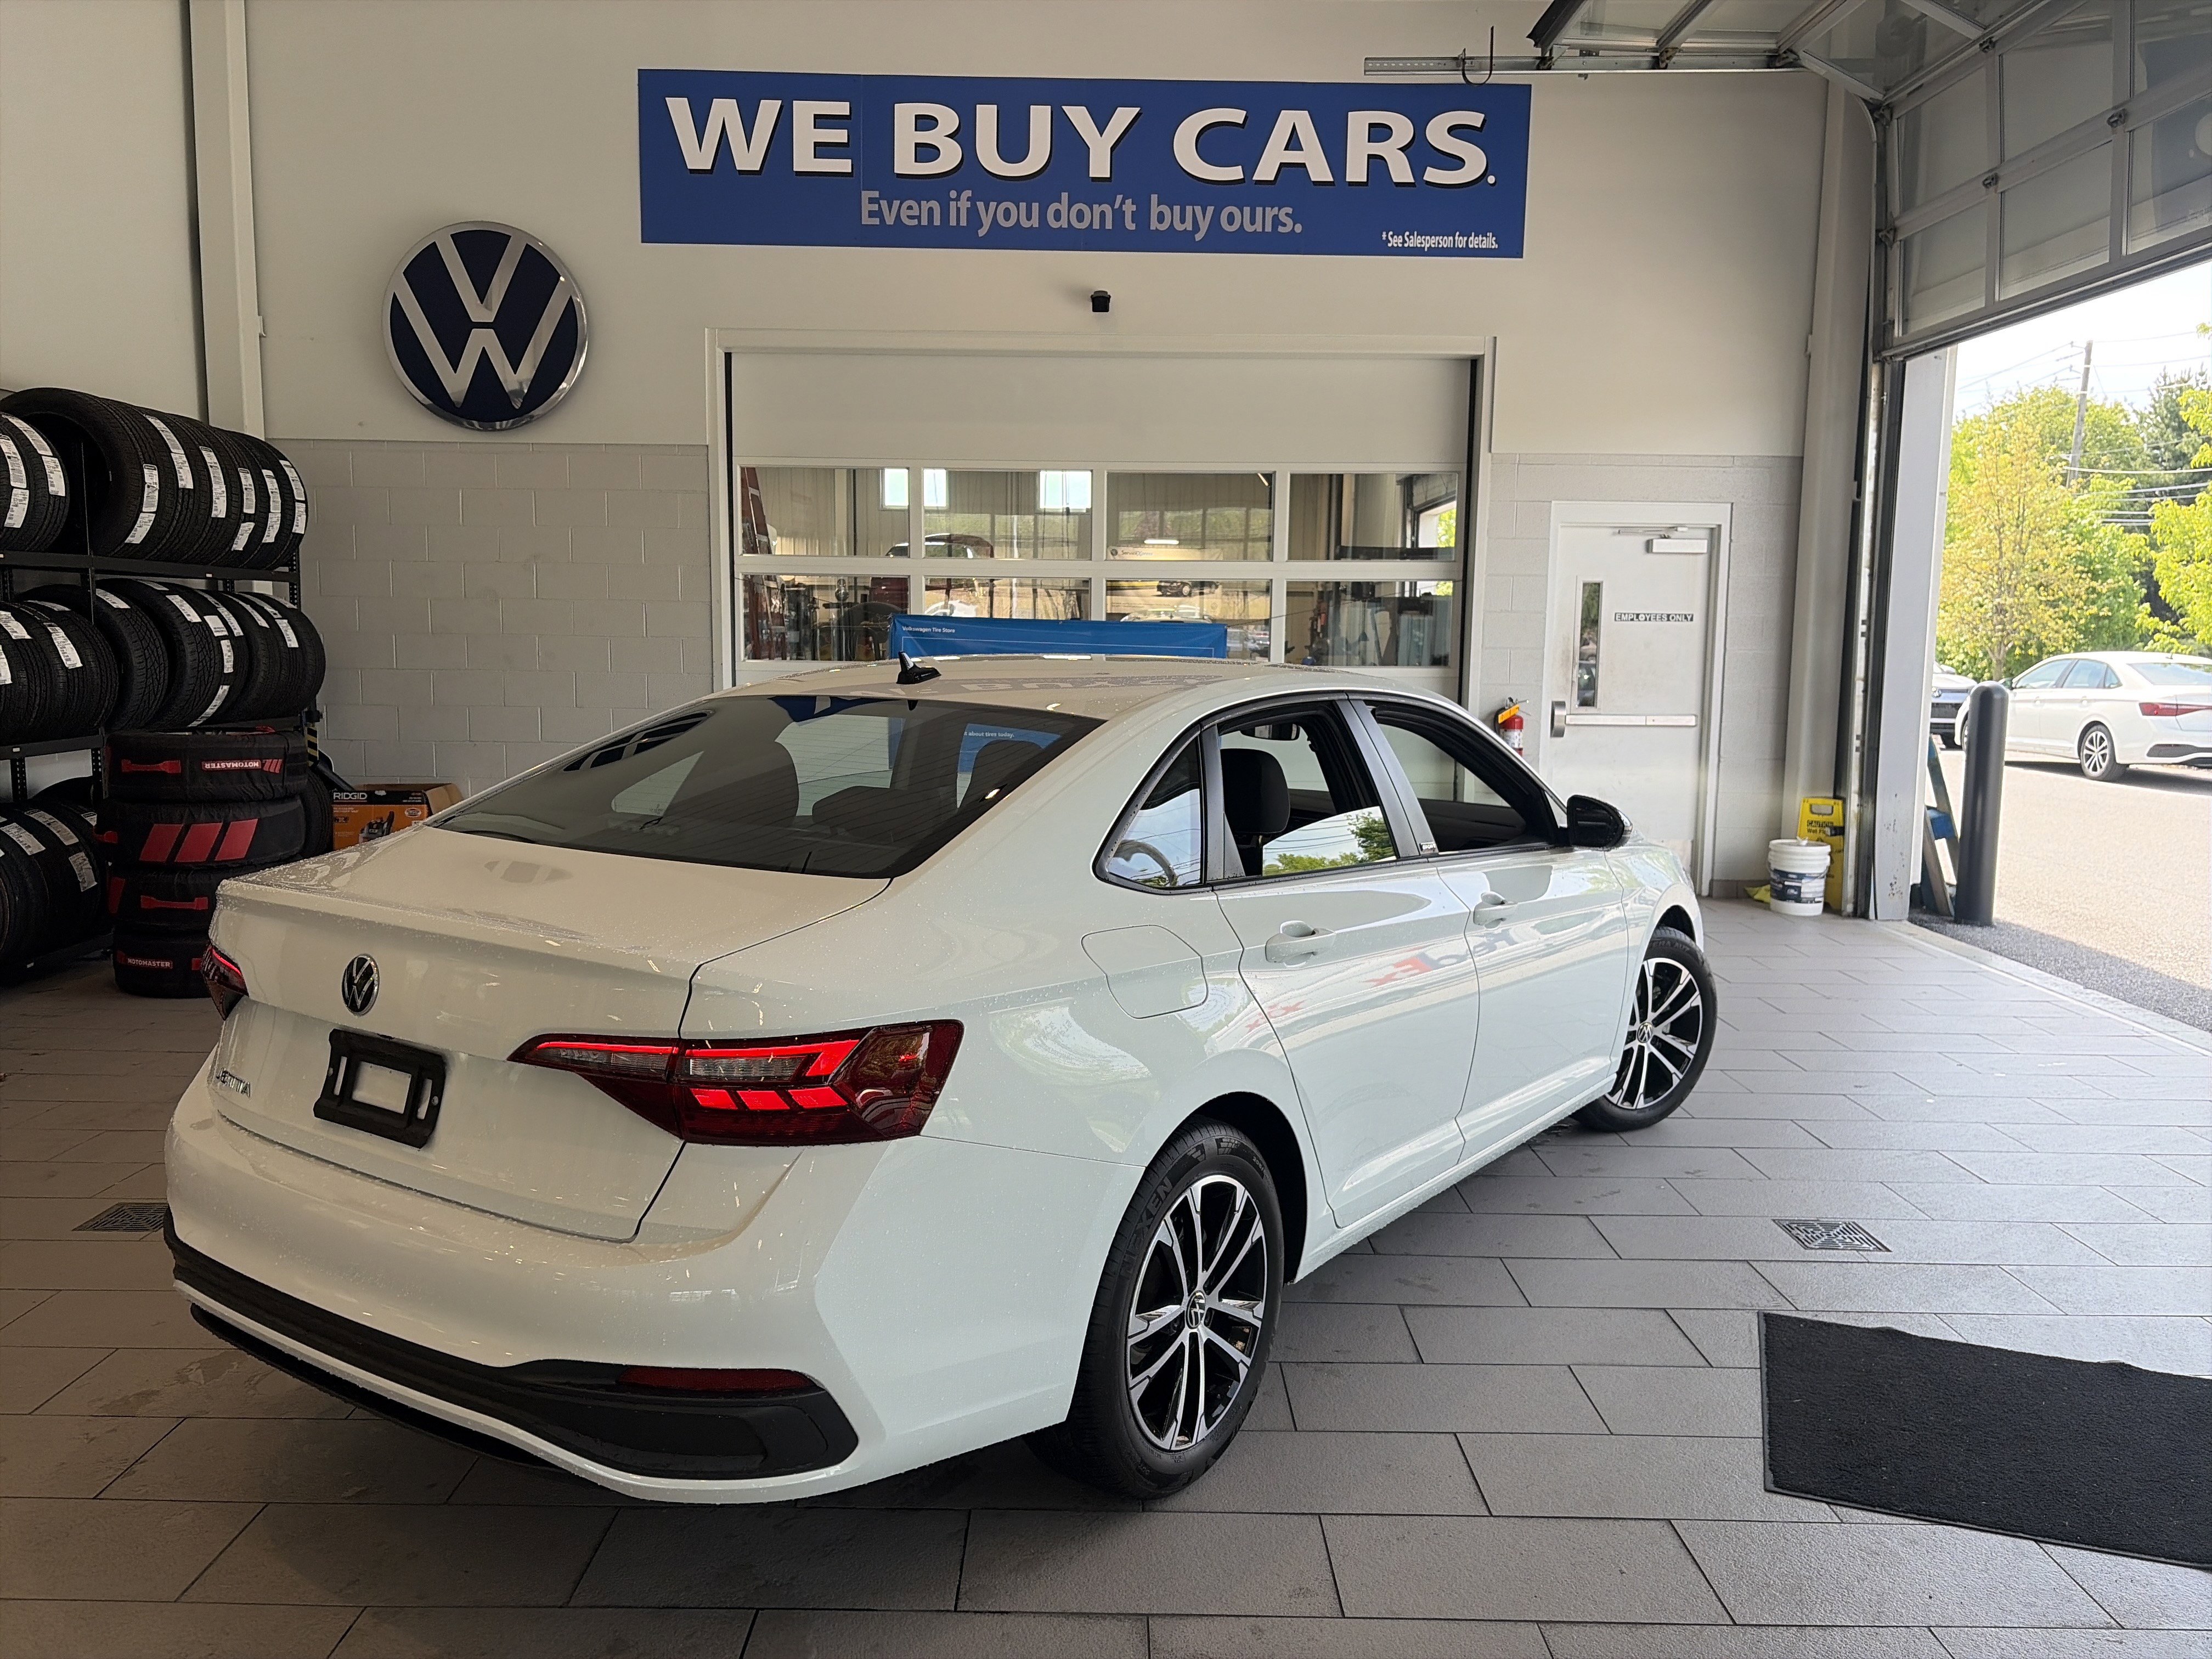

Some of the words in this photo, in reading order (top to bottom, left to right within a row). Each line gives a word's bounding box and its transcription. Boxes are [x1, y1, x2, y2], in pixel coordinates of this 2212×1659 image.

[665, 97, 853, 176] WE
[894, 103, 1142, 181] BUY
[1173, 108, 1497, 187] CARS.
[861, 190, 940, 225] Even
[950, 190, 972, 226] if
[976, 201, 1039, 237] you
[1047, 193, 1136, 230] don't
[1150, 194, 1214, 241] buy
[1220, 205, 1303, 233] ours.
[1404, 231, 1454, 251] Salesperson
[1455, 231, 1468, 249] for
[1468, 232, 1498, 249] details.
[1615, 613, 1667, 621] EMPLOYEES
[1669, 613, 1693, 622] ONLY
[127, 958, 171, 967] MOTOMASTER
[217, 1067, 251, 1098] JETTA
[1120, 1176, 1173, 1277] NEXEN
